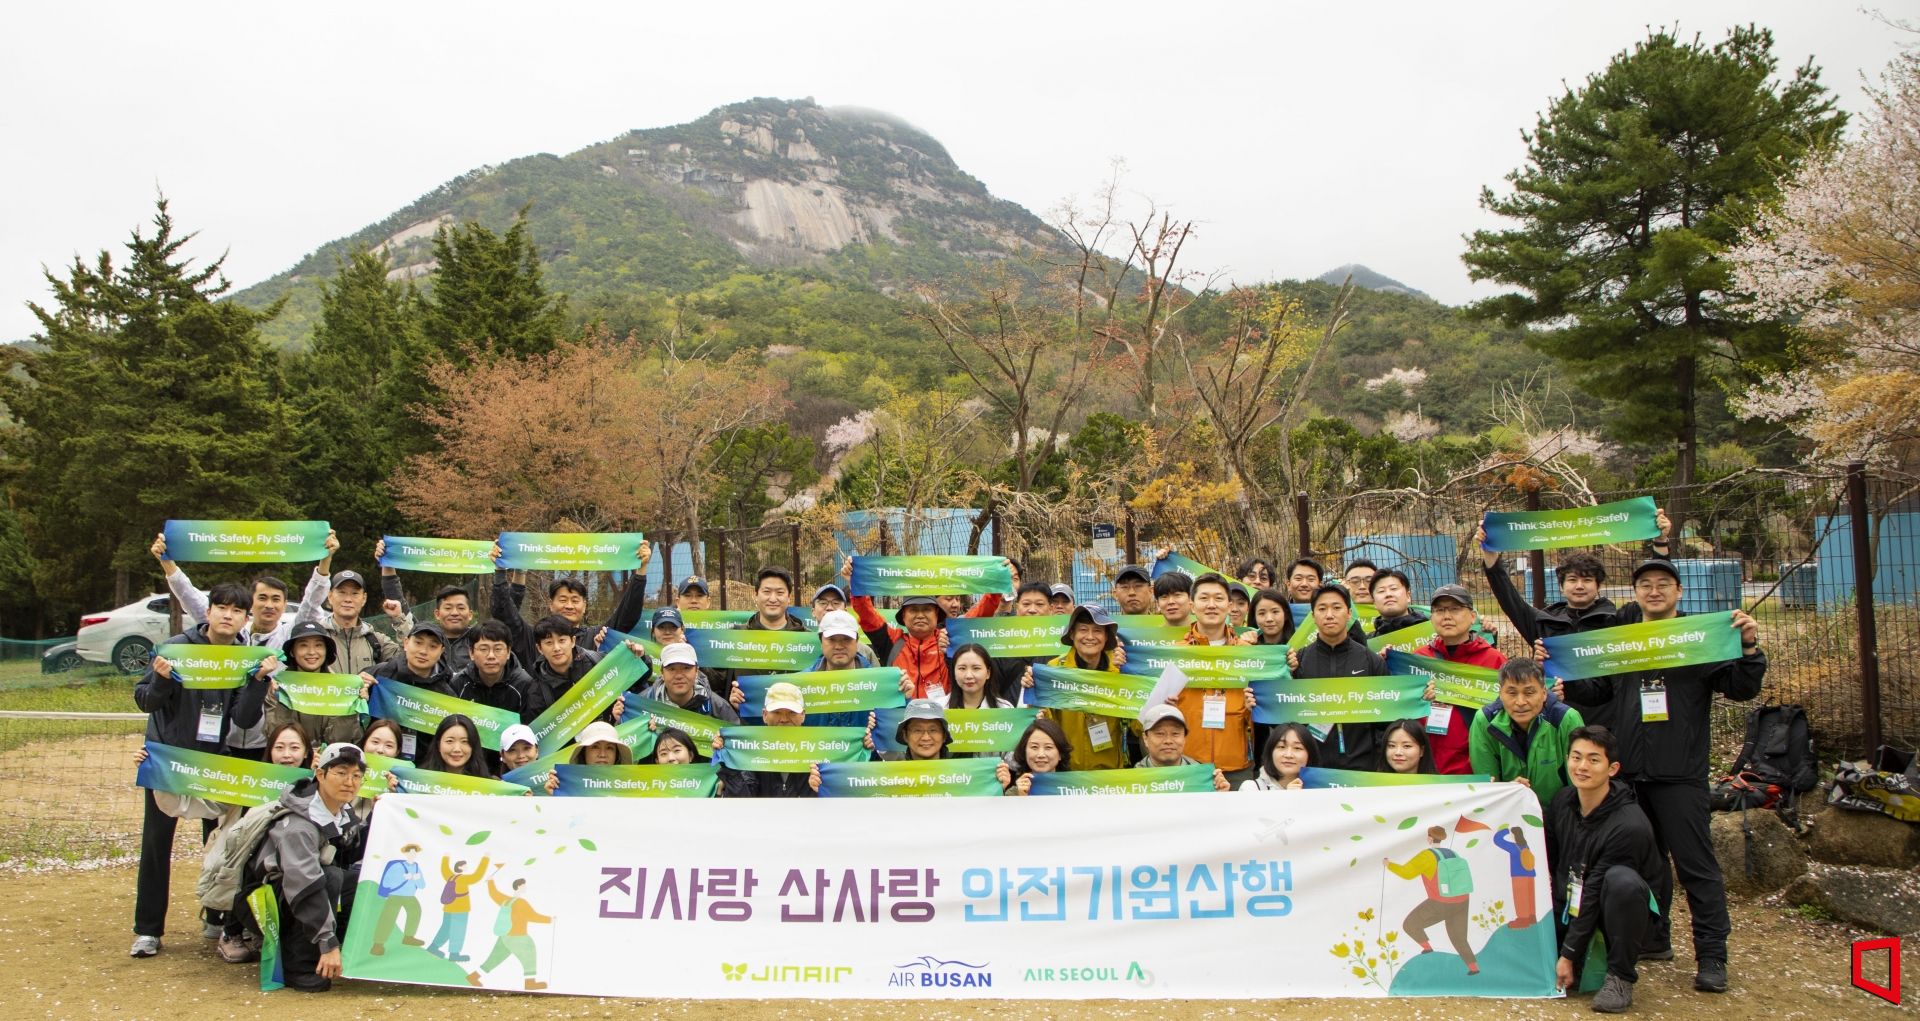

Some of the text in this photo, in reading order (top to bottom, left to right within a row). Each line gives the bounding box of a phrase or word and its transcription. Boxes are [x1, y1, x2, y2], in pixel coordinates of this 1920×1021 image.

[1507, 511, 1629, 532] Think Safety, Fly Safely
[188, 532, 305, 545] Think Safety, Fly Safely
[402, 545, 427, 556] Think
[429, 547, 460, 559] Safety,
[461, 549, 475, 559] Fly
[518, 543, 620, 554] Think Safety, Fly Safely
[876, 567, 985, 579] Think Safety, Fly Safely
[969, 629, 997, 638] Think
[998, 628, 1031, 639] Safety,
[1033, 627, 1047, 638] Fly
[709, 640, 815, 654] Think Safety, Fly Safely
[1130, 639, 1157, 647] Think
[1572, 630, 1706, 658] Think Safety, Fly Safely
[168, 658, 183, 668] ink
[185, 658, 221, 671] Safety,
[223, 659, 239, 670] Fly
[1178, 658, 1214, 670] Safety,
[1215, 659, 1231, 670] Fly
[1233, 658, 1266, 670] Safely
[1408, 665, 1437, 680] Think
[1439, 672, 1473, 690] Safety,
[1475, 679, 1490, 692] Fly
[289, 684, 324, 696] Safety,
[327, 685, 342, 696] Fly
[800, 680, 878, 696] afety, Fly Safely
[1051, 679, 1079, 692] Think
[1081, 684, 1116, 698] Safety,
[1118, 688, 1134, 700] Fly
[556, 700, 584, 725] Safety,
[582, 686, 596, 703] Fly
[594, 666, 619, 689] Safely
[1276, 690, 1401, 704] Think Safety, Fly Safely
[396, 695, 421, 710] Think
[472, 715, 500, 731] Safely
[668, 720, 701, 736] Safety,
[964, 721, 980, 733] Fly
[982, 720, 1014, 732] Safely
[730, 739, 850, 752] Think Safety, Fly Safely
[170, 760, 288, 790] Think Safety, Fly Safel
[847, 773, 972, 788] Think Safety, Fly Safely
[403, 779, 431, 793] Think
[582, 778, 701, 791] Think Safety, Fly Safely
[1057, 785, 1088, 795] Think
[1131, 783, 1149, 794] Fly
[1150, 780, 1185, 792] Safely
[598, 859, 1294, 923] 진사랑 산사랑 안전기원산행
[888, 972, 992, 988] AIR BUSAN
[1023, 967, 1119, 982] AIR SEOUL
